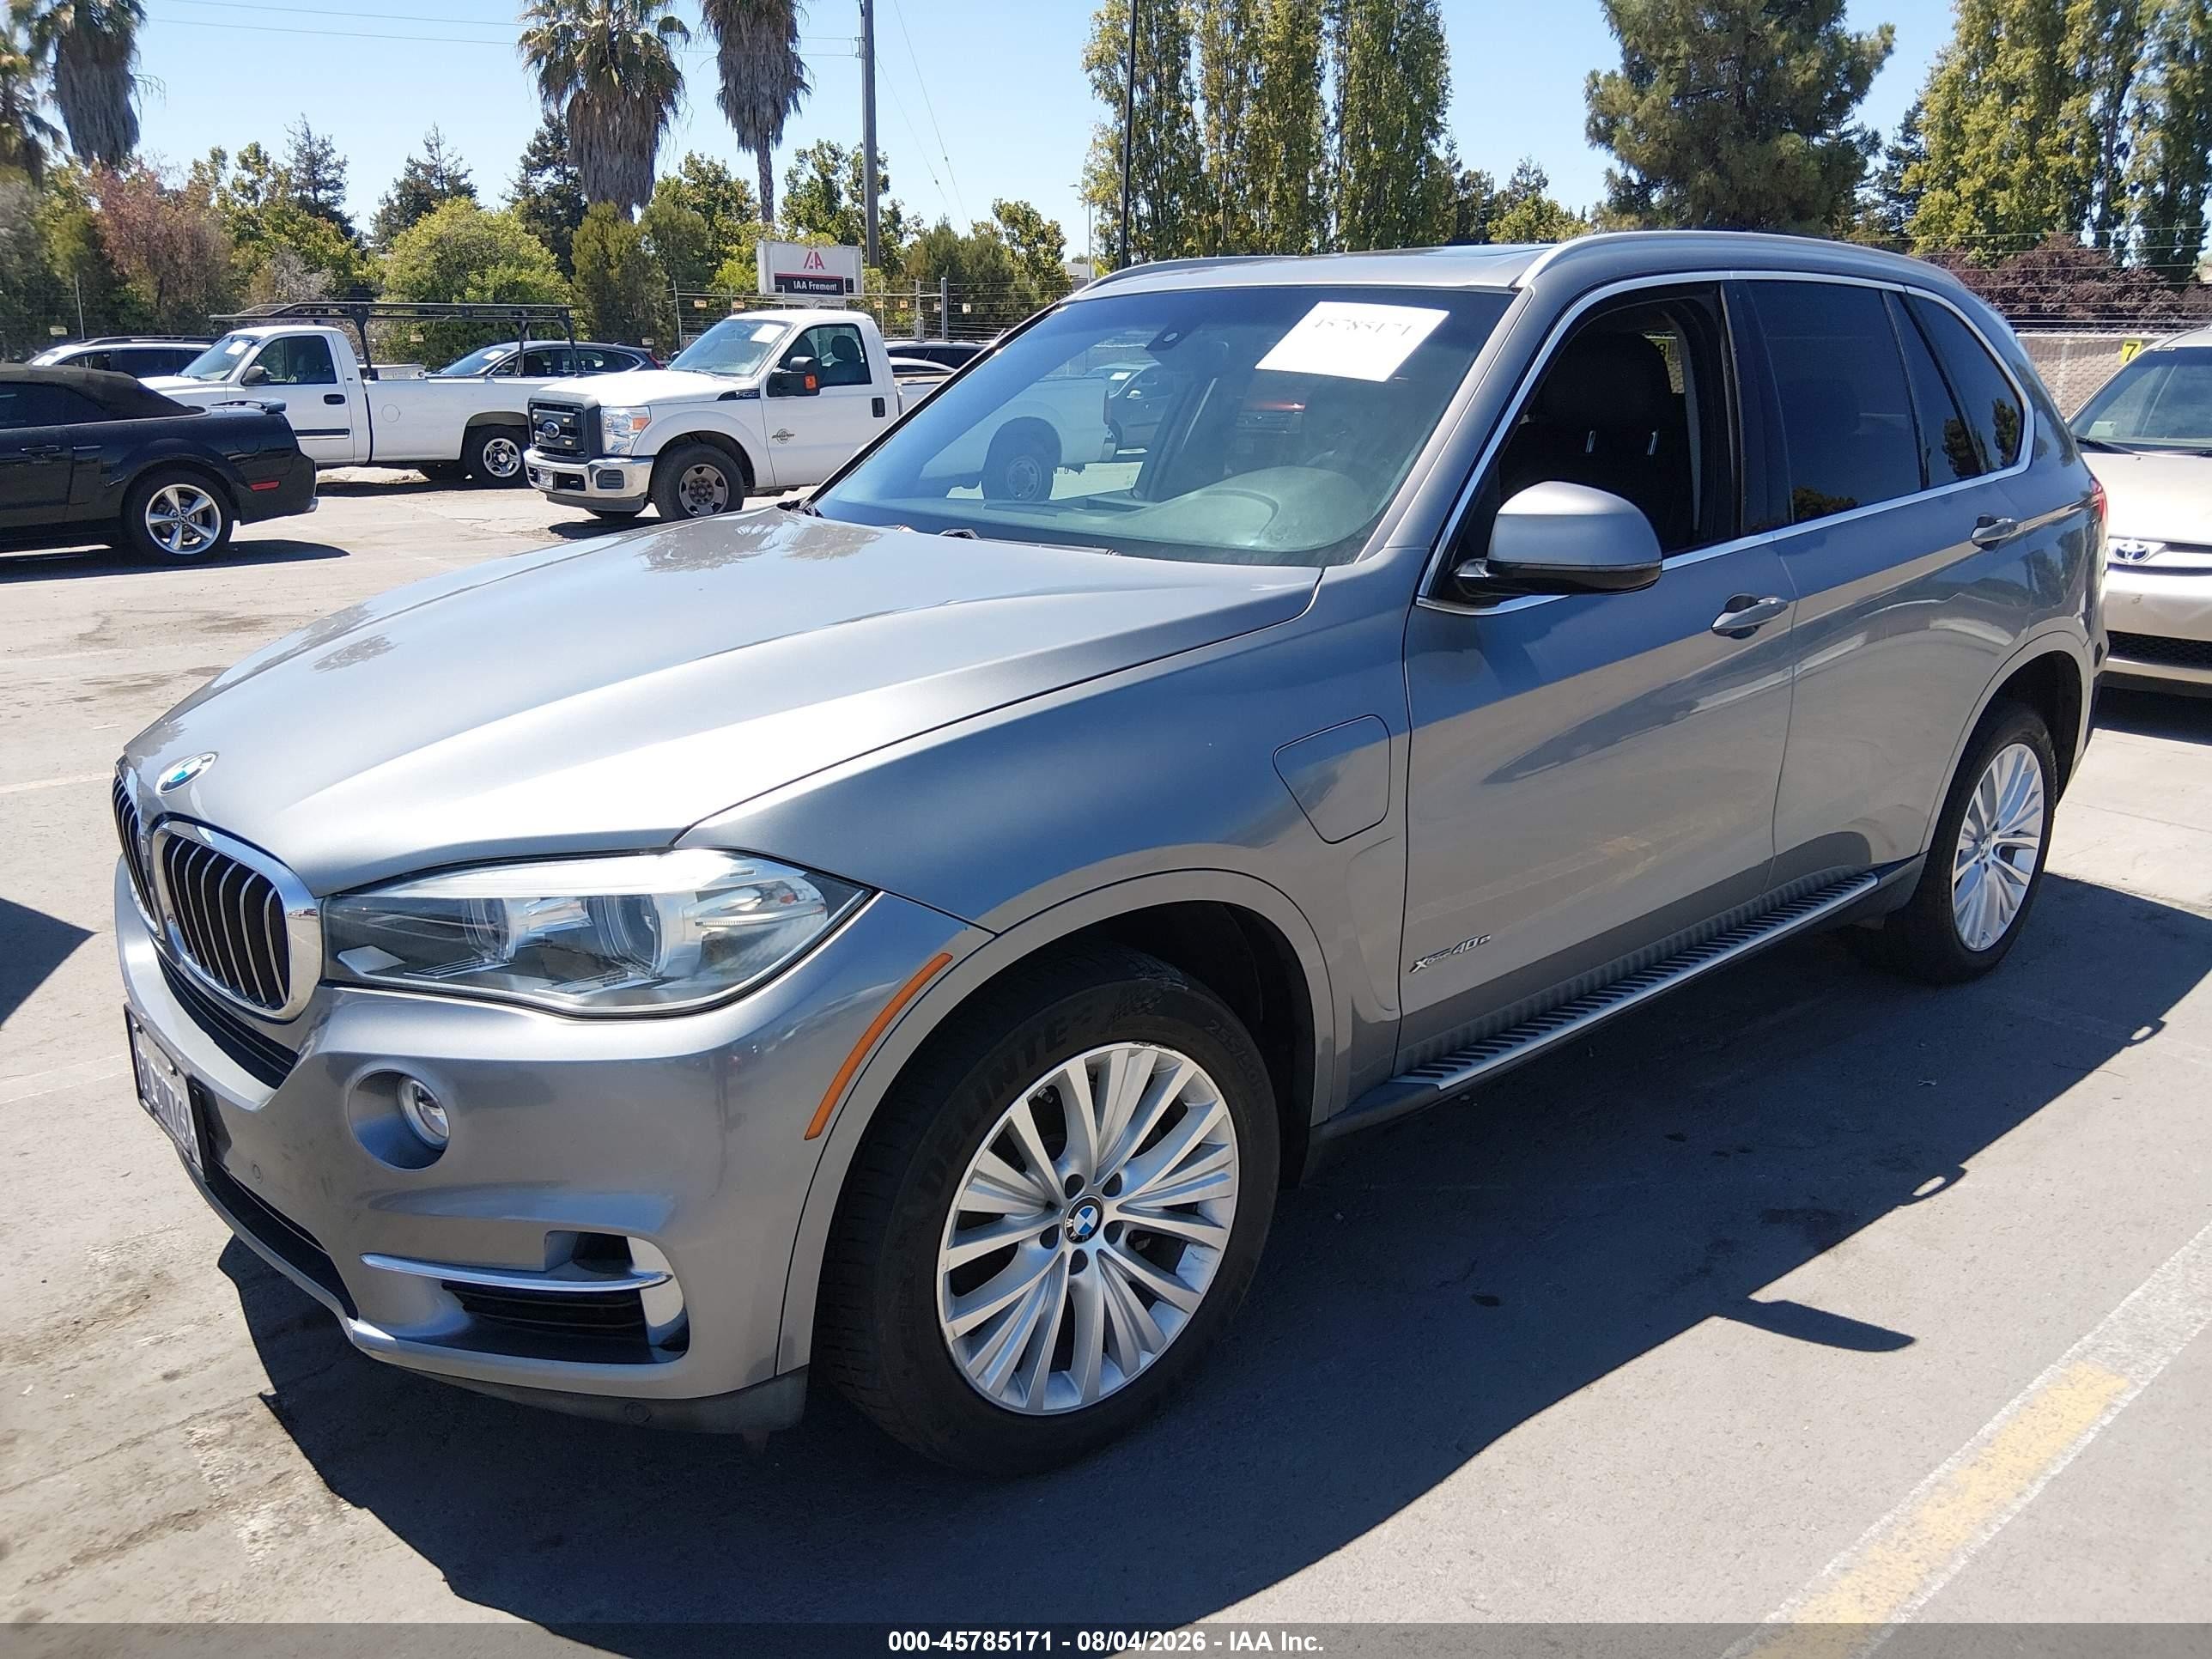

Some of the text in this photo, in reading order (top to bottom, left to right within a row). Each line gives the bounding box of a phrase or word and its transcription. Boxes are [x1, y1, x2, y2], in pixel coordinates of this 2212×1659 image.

[793, 280, 838, 292] IAA Fremont
[2125, 343, 2139, 362] 7
